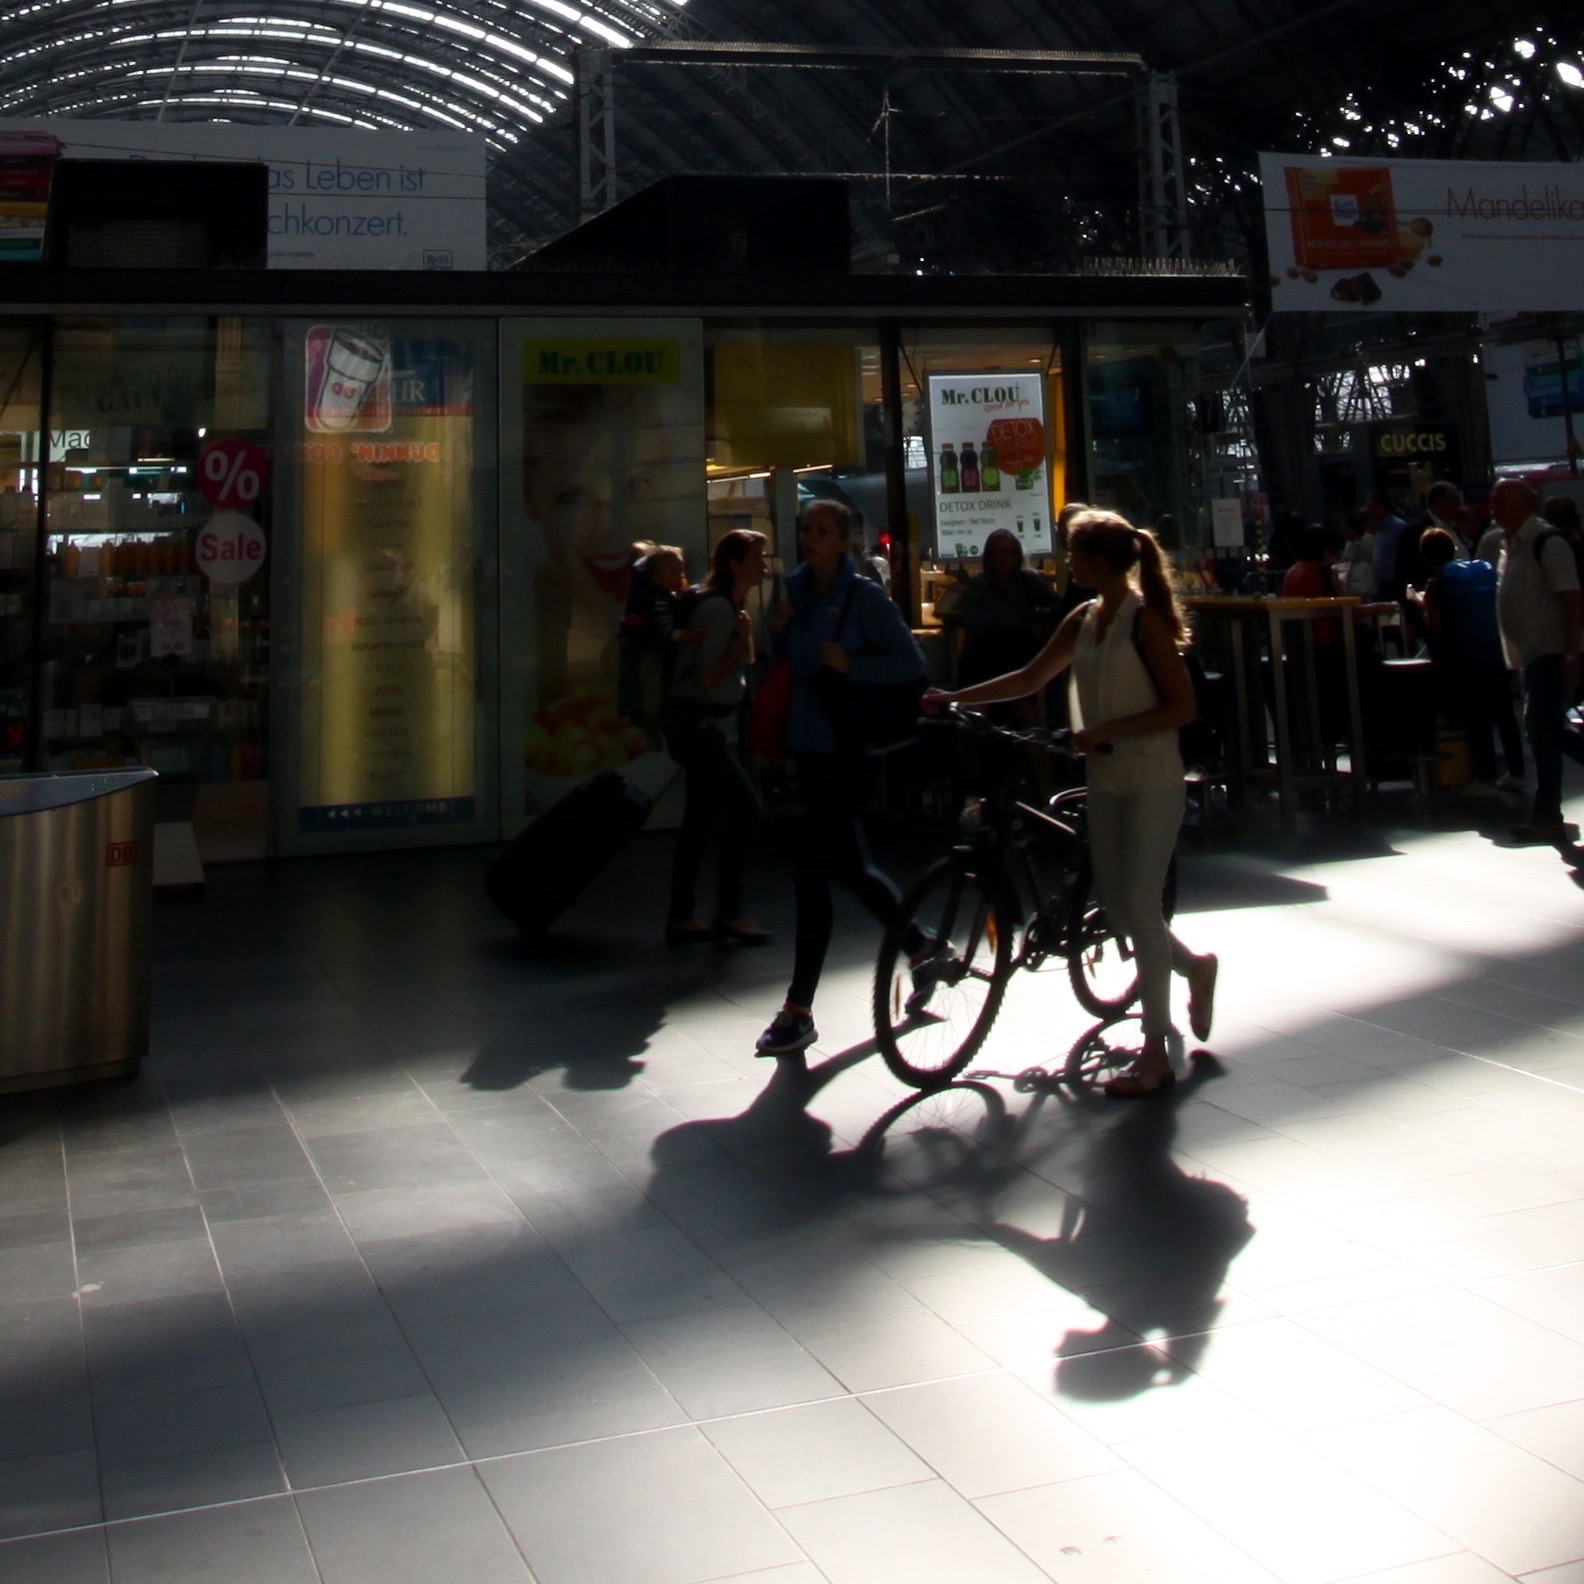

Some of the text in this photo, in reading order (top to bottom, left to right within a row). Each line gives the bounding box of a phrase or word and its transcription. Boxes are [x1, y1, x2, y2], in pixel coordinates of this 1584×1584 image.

[306, 158, 391, 192] Leben
[400, 166, 426, 193] ist
[267, 203, 409, 237] chkonzert.
[587, 349, 665, 374] CLOU
[941, 386, 1020, 405] Mr. CLOU
[1380, 433, 1447, 452] CUCCIS
[939, 499, 1012, 513] DETOX DRINK
[201, 533, 261, 562] Sale
[108, 844, 136, 865] DB
